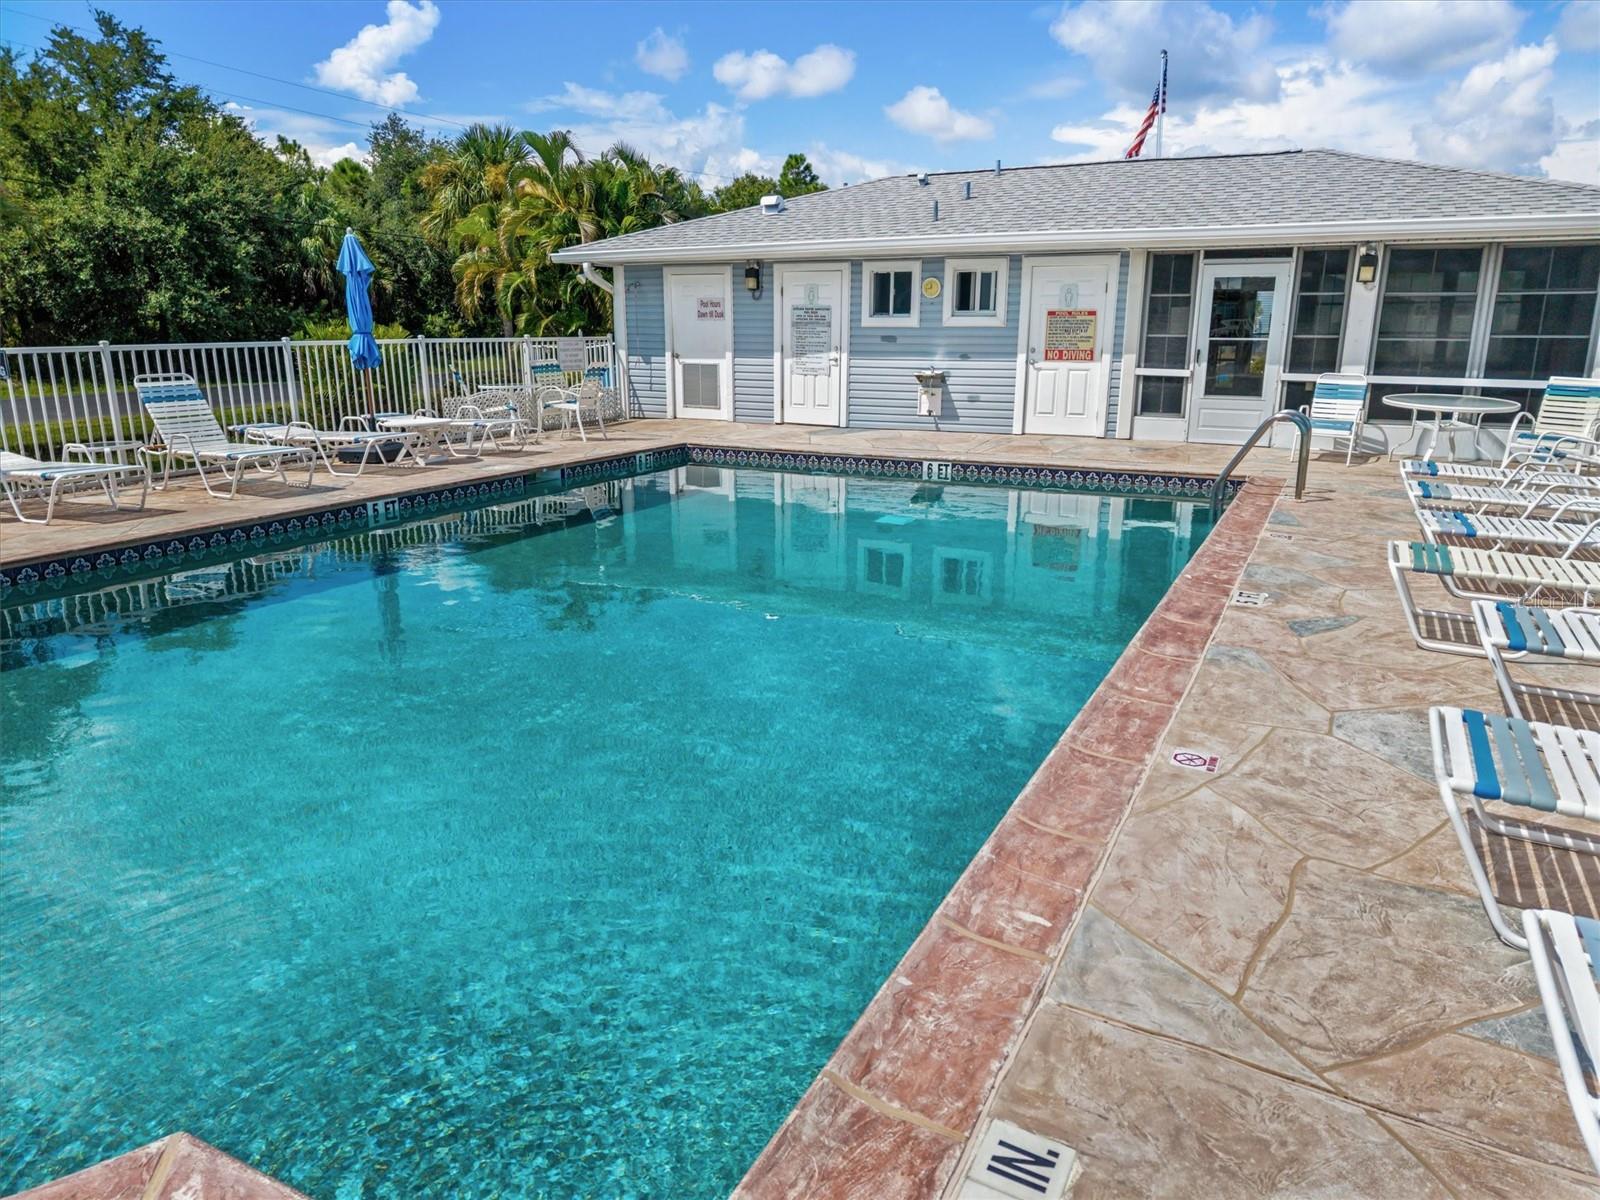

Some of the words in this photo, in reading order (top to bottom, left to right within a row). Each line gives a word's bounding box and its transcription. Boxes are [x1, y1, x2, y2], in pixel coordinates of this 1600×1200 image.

[1047, 350, 1060, 360] NO
[1062, 350, 1092, 360] DIVING
[927, 462, 934, 479] 6
[372, 502, 380, 524] 5
[987, 1140, 1060, 1194] IN.
